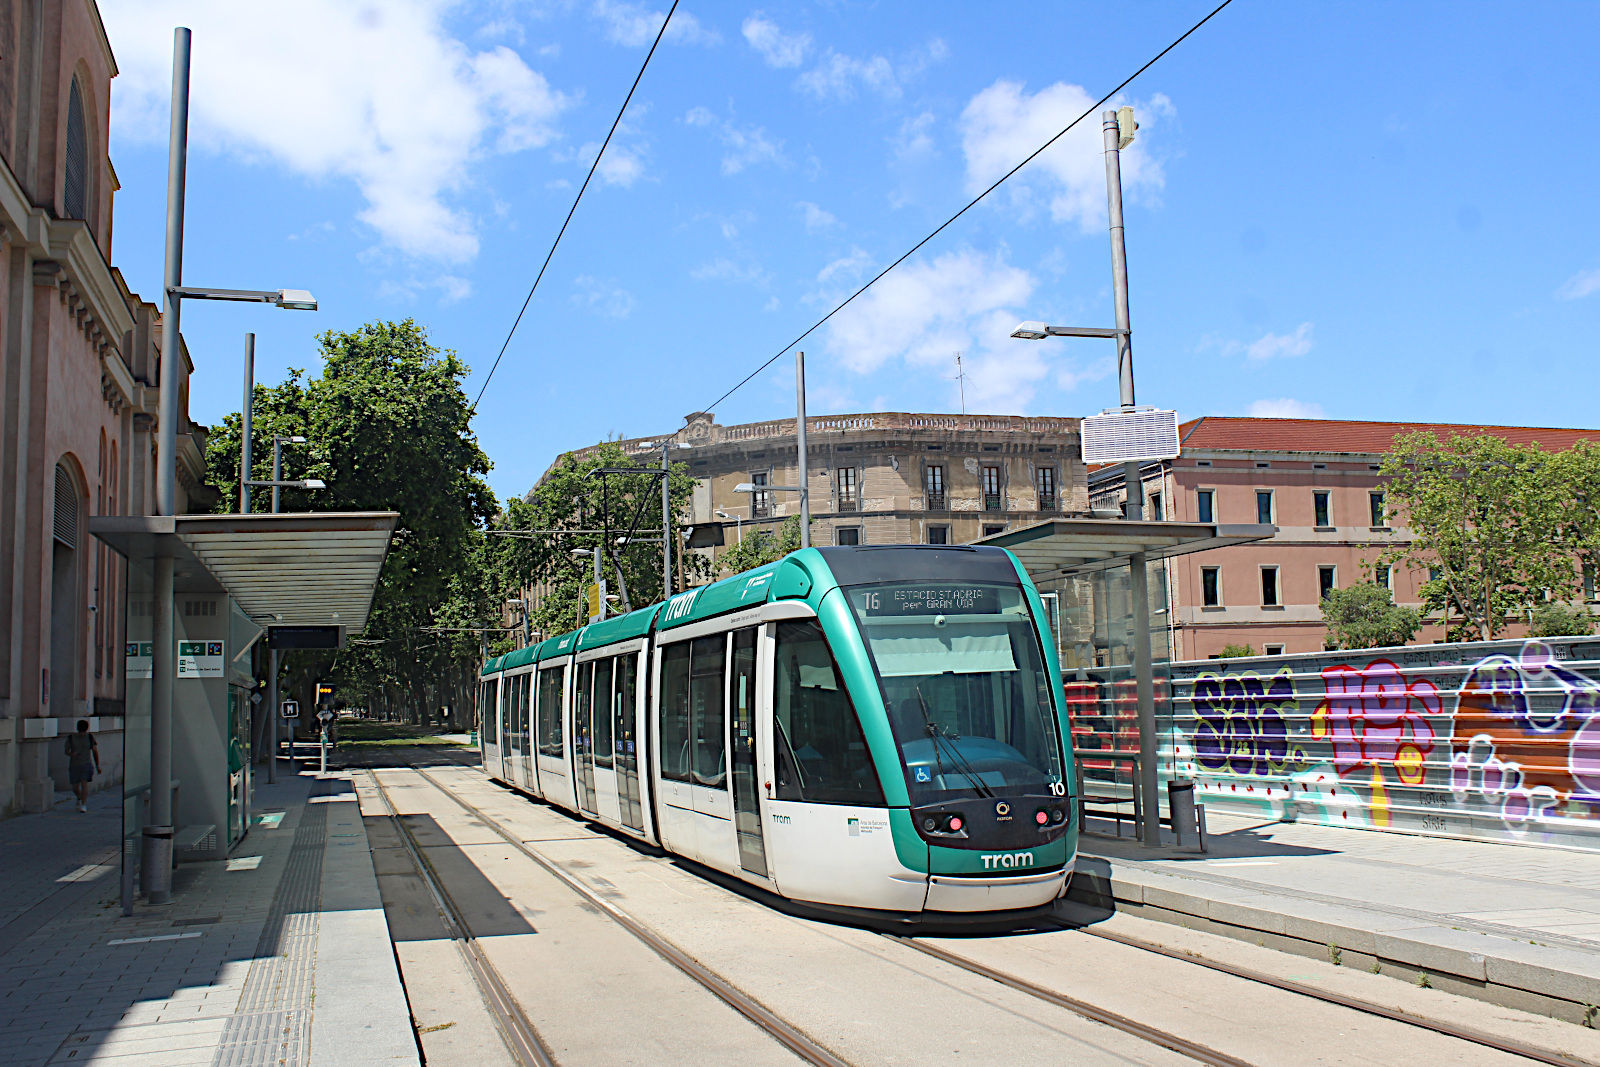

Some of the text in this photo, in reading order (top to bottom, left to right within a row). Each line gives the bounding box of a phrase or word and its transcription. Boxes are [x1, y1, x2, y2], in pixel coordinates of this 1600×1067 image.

[861, 592, 881, 610] T6
[902, 599, 974, 610] per GRAN VIA
[194, 645, 200, 653] 2
[286, 704, 294, 715] M
[1048, 782, 1065, 796] 10
